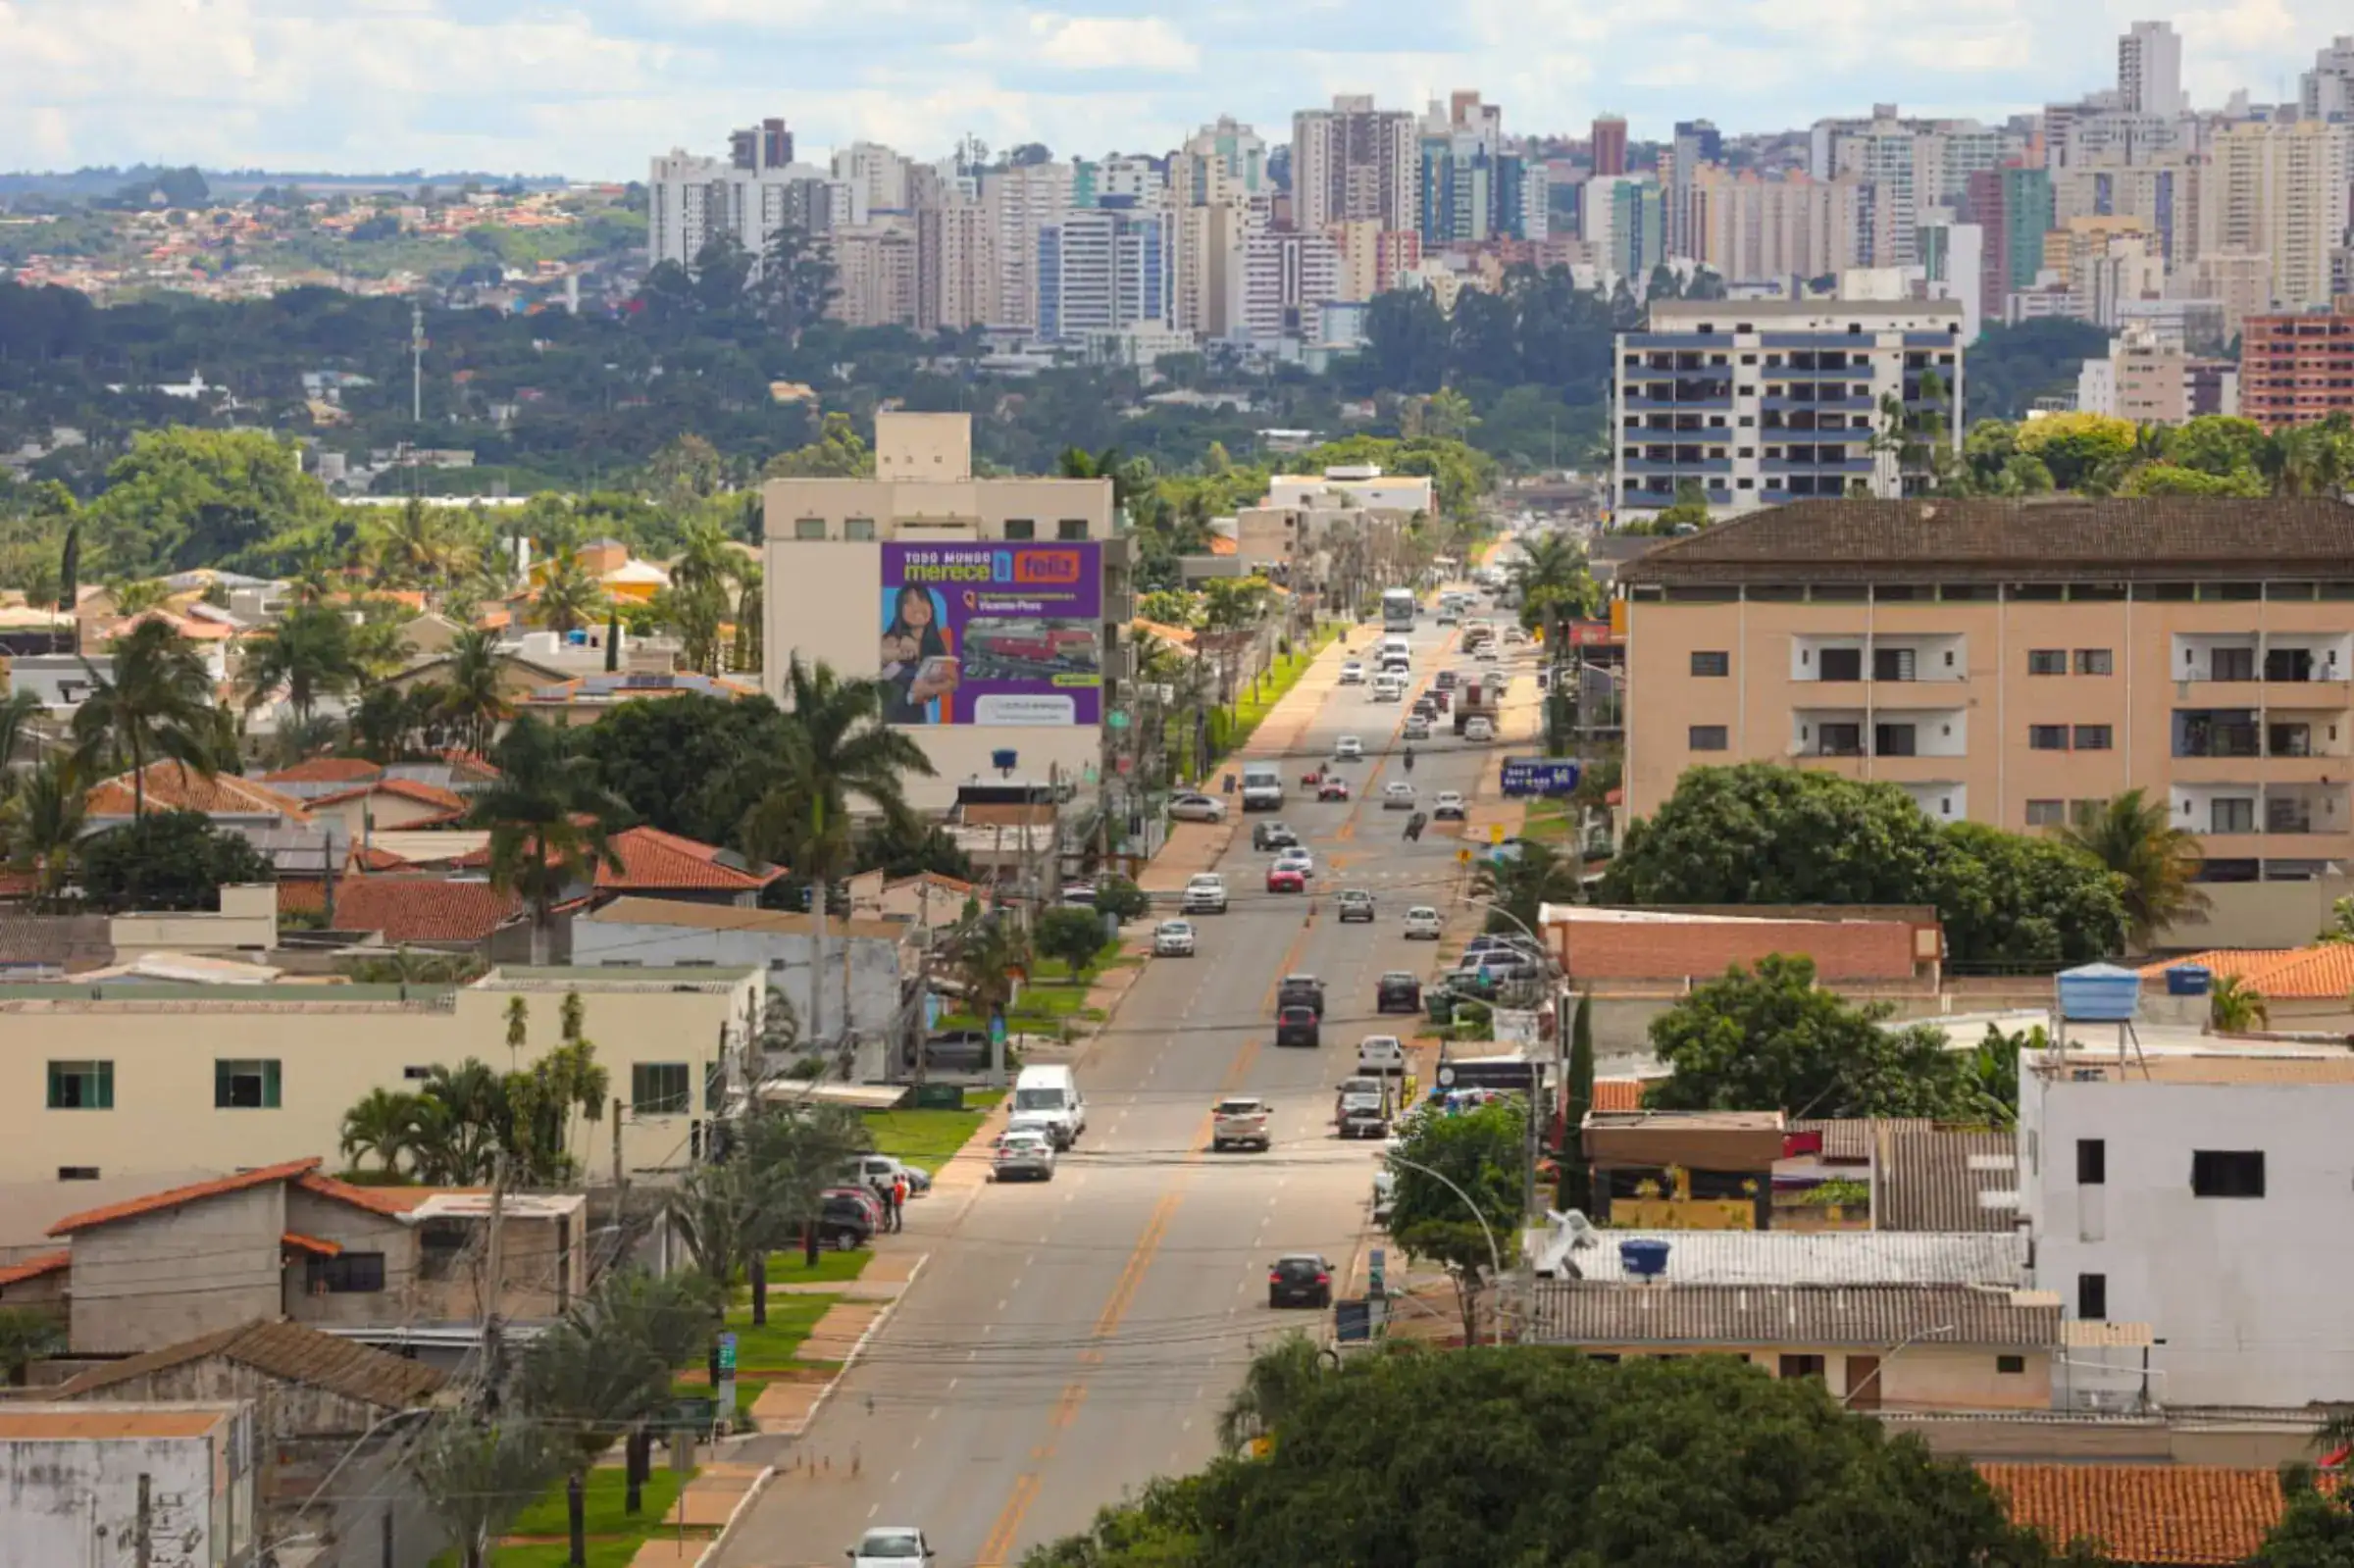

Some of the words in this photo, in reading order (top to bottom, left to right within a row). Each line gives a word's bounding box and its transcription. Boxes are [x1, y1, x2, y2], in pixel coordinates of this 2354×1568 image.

[904, 551, 939, 564] TODO
[945, 551, 991, 564] MUNDO
[904, 565, 991, 582] merece
